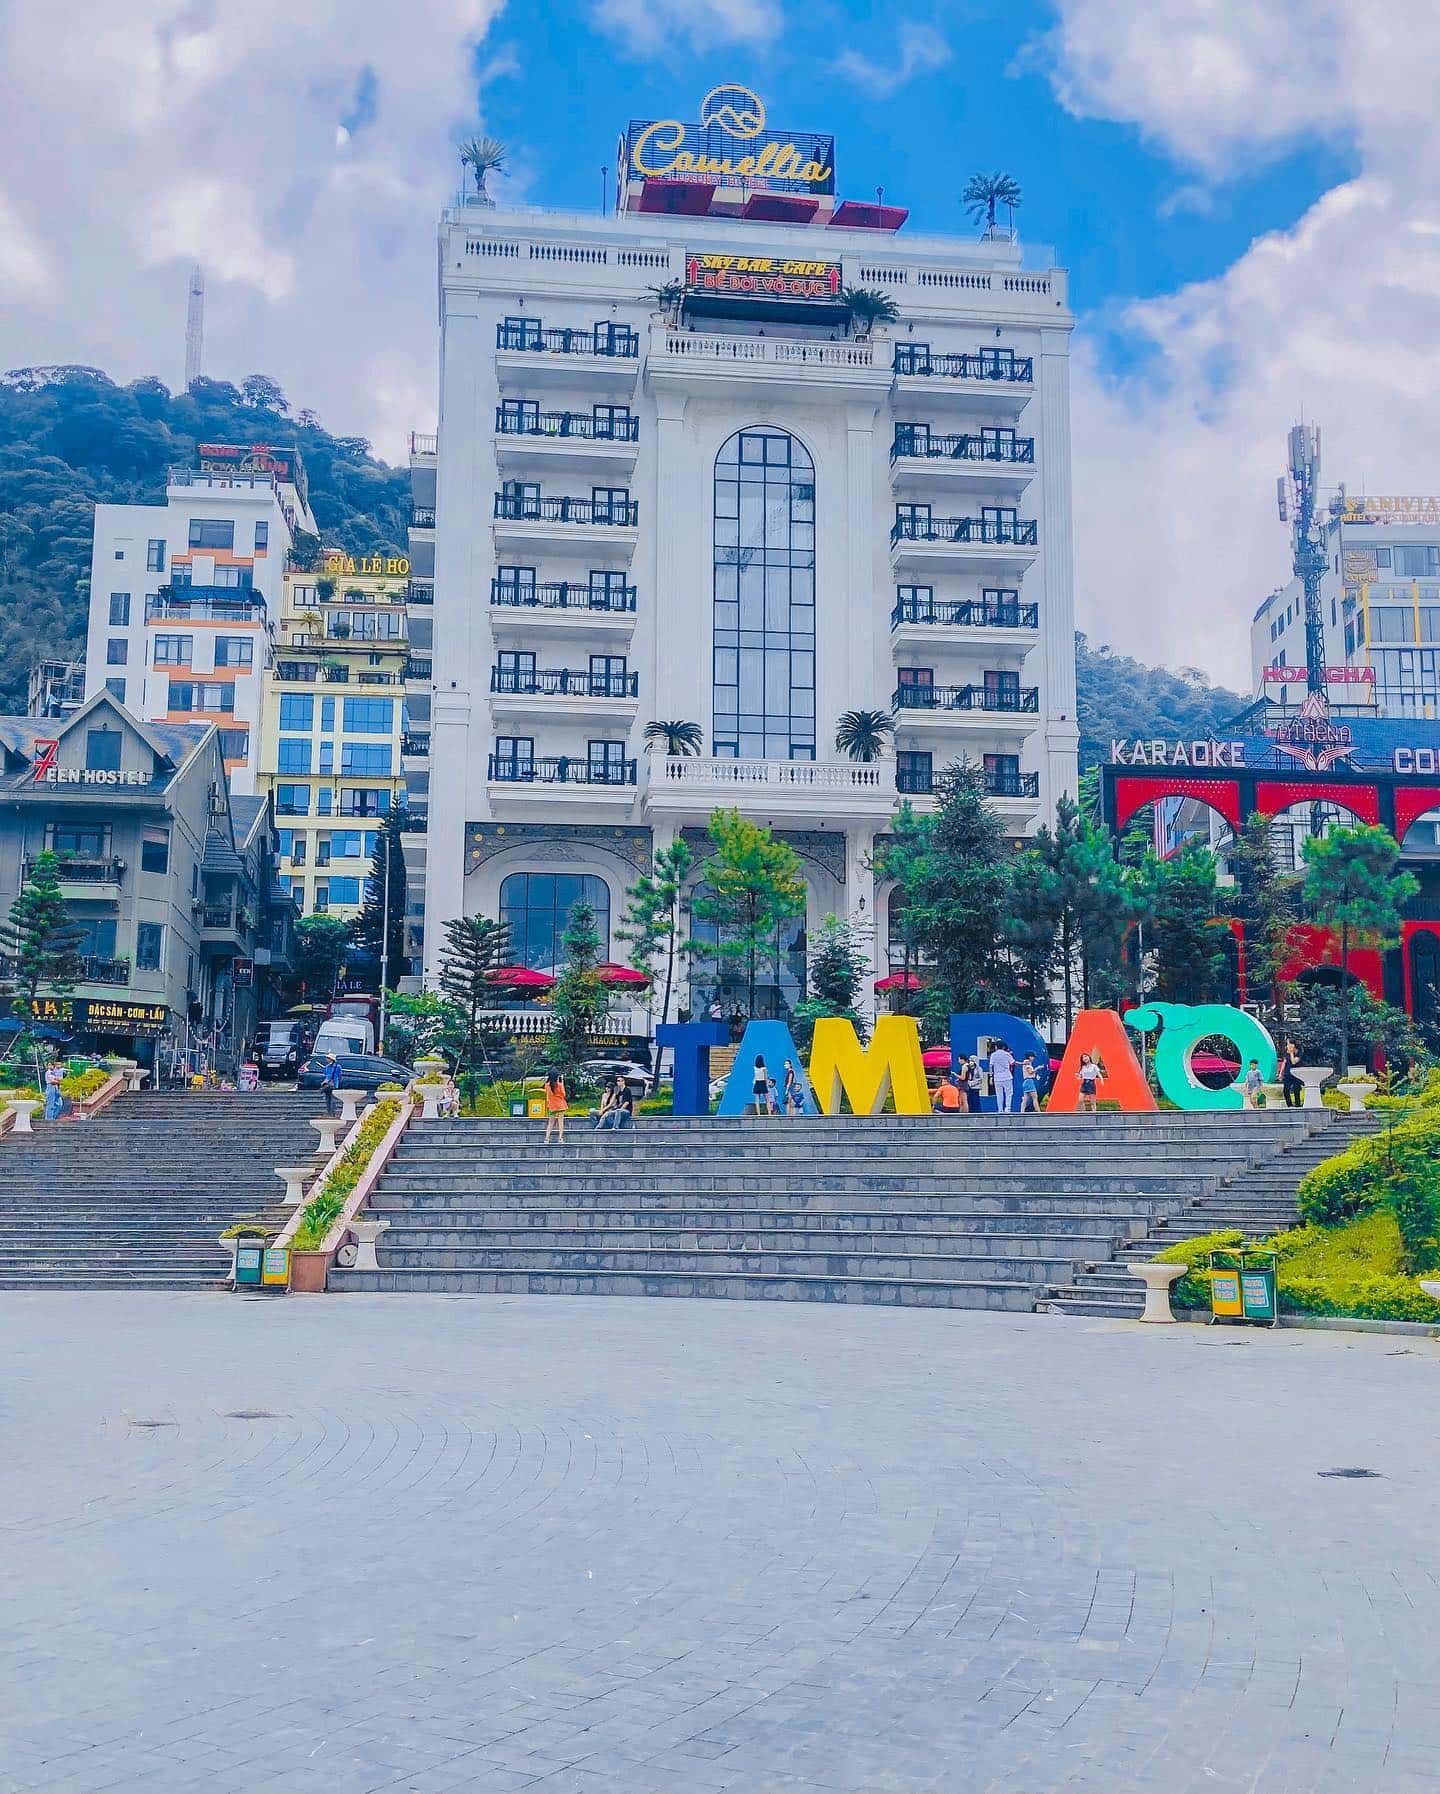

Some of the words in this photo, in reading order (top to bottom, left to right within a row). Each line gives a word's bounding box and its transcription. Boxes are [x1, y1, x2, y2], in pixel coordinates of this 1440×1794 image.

[634, 120, 831, 182] Camellia
[701, 255, 733, 269] SKY
[736, 257, 772, 272] BAR
[328, 555, 356, 573] GIA
[360, 551, 382, 573] LÊ
[1111, 739, 1247, 768] KARAOKE
[1394, 747, 1440, 774] CO
[84, 769, 149, 785] HOSTEL
[655, 1015, 933, 1116] TAM
